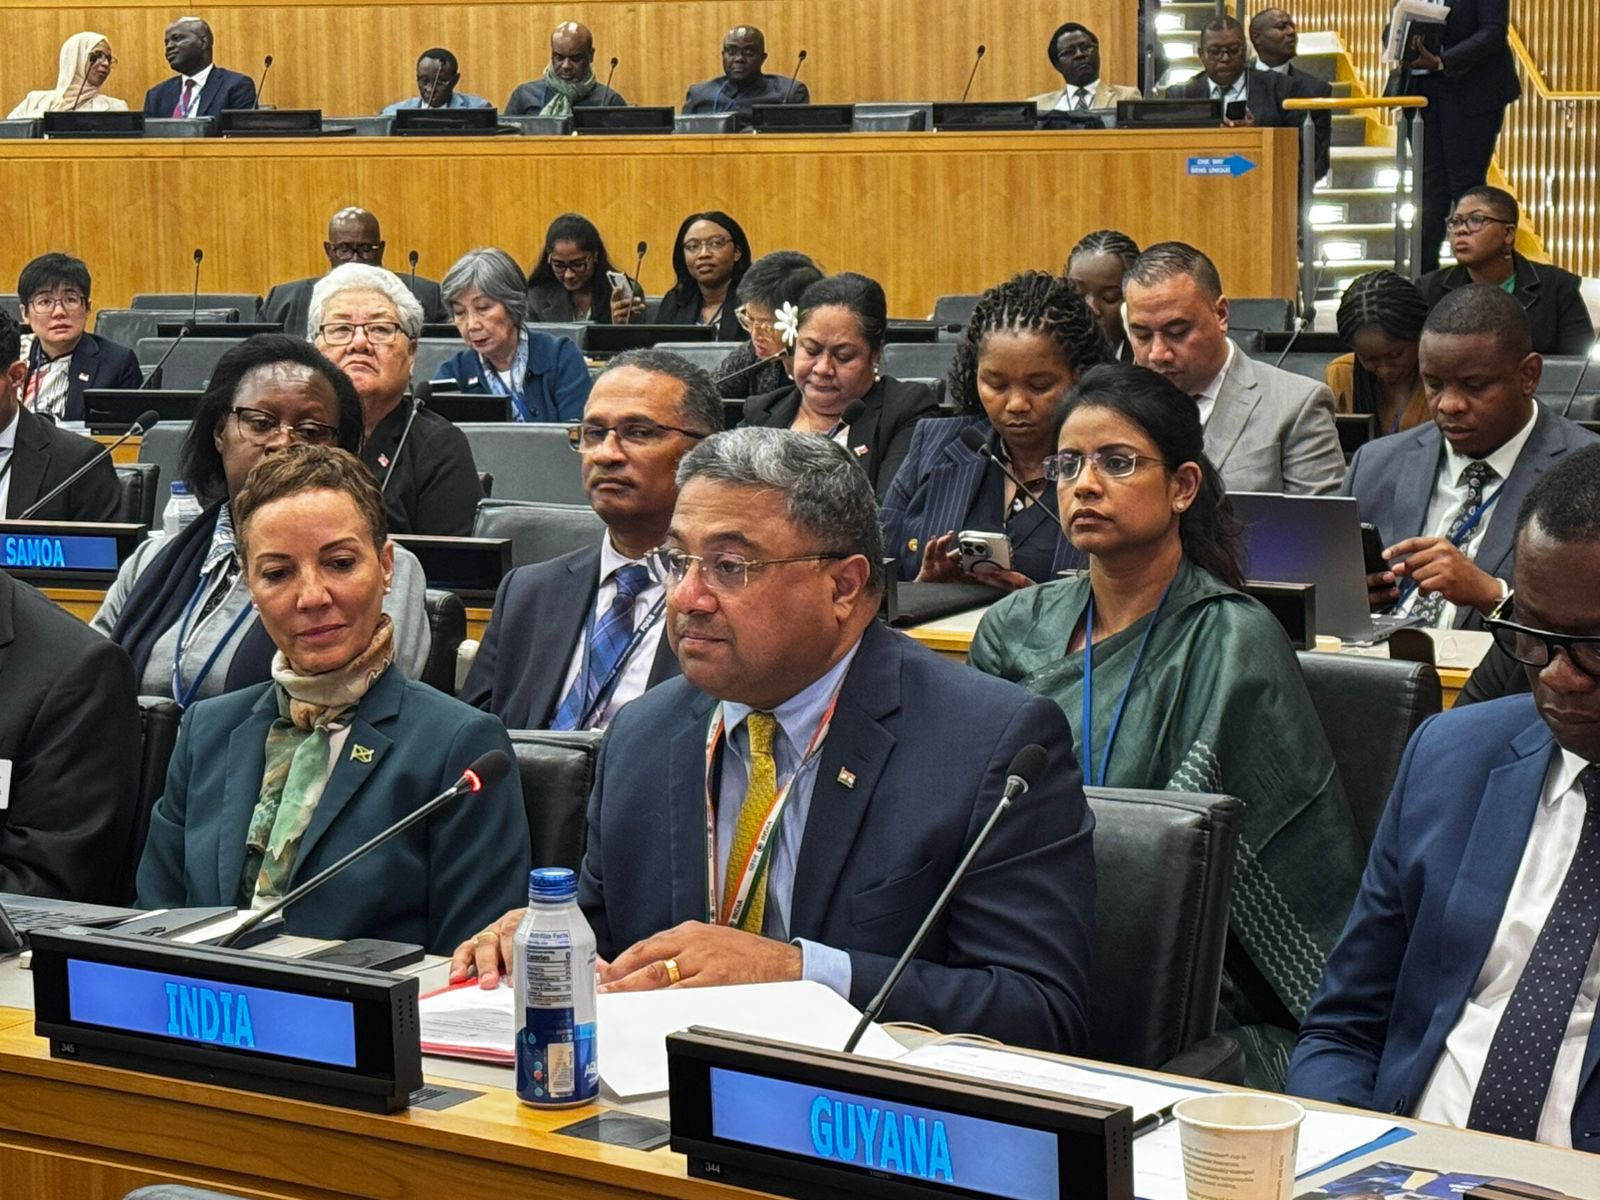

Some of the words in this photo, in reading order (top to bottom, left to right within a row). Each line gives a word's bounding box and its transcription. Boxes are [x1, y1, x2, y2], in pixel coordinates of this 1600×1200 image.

[6, 537, 65, 567] SAMOA
[732, 900, 743, 920] INDIA
[164, 982, 256, 1048] INDIA
[61, 1042, 75, 1054] 345
[810, 1095, 954, 1183] GUYANA
[705, 1161, 721, 1174] 344
